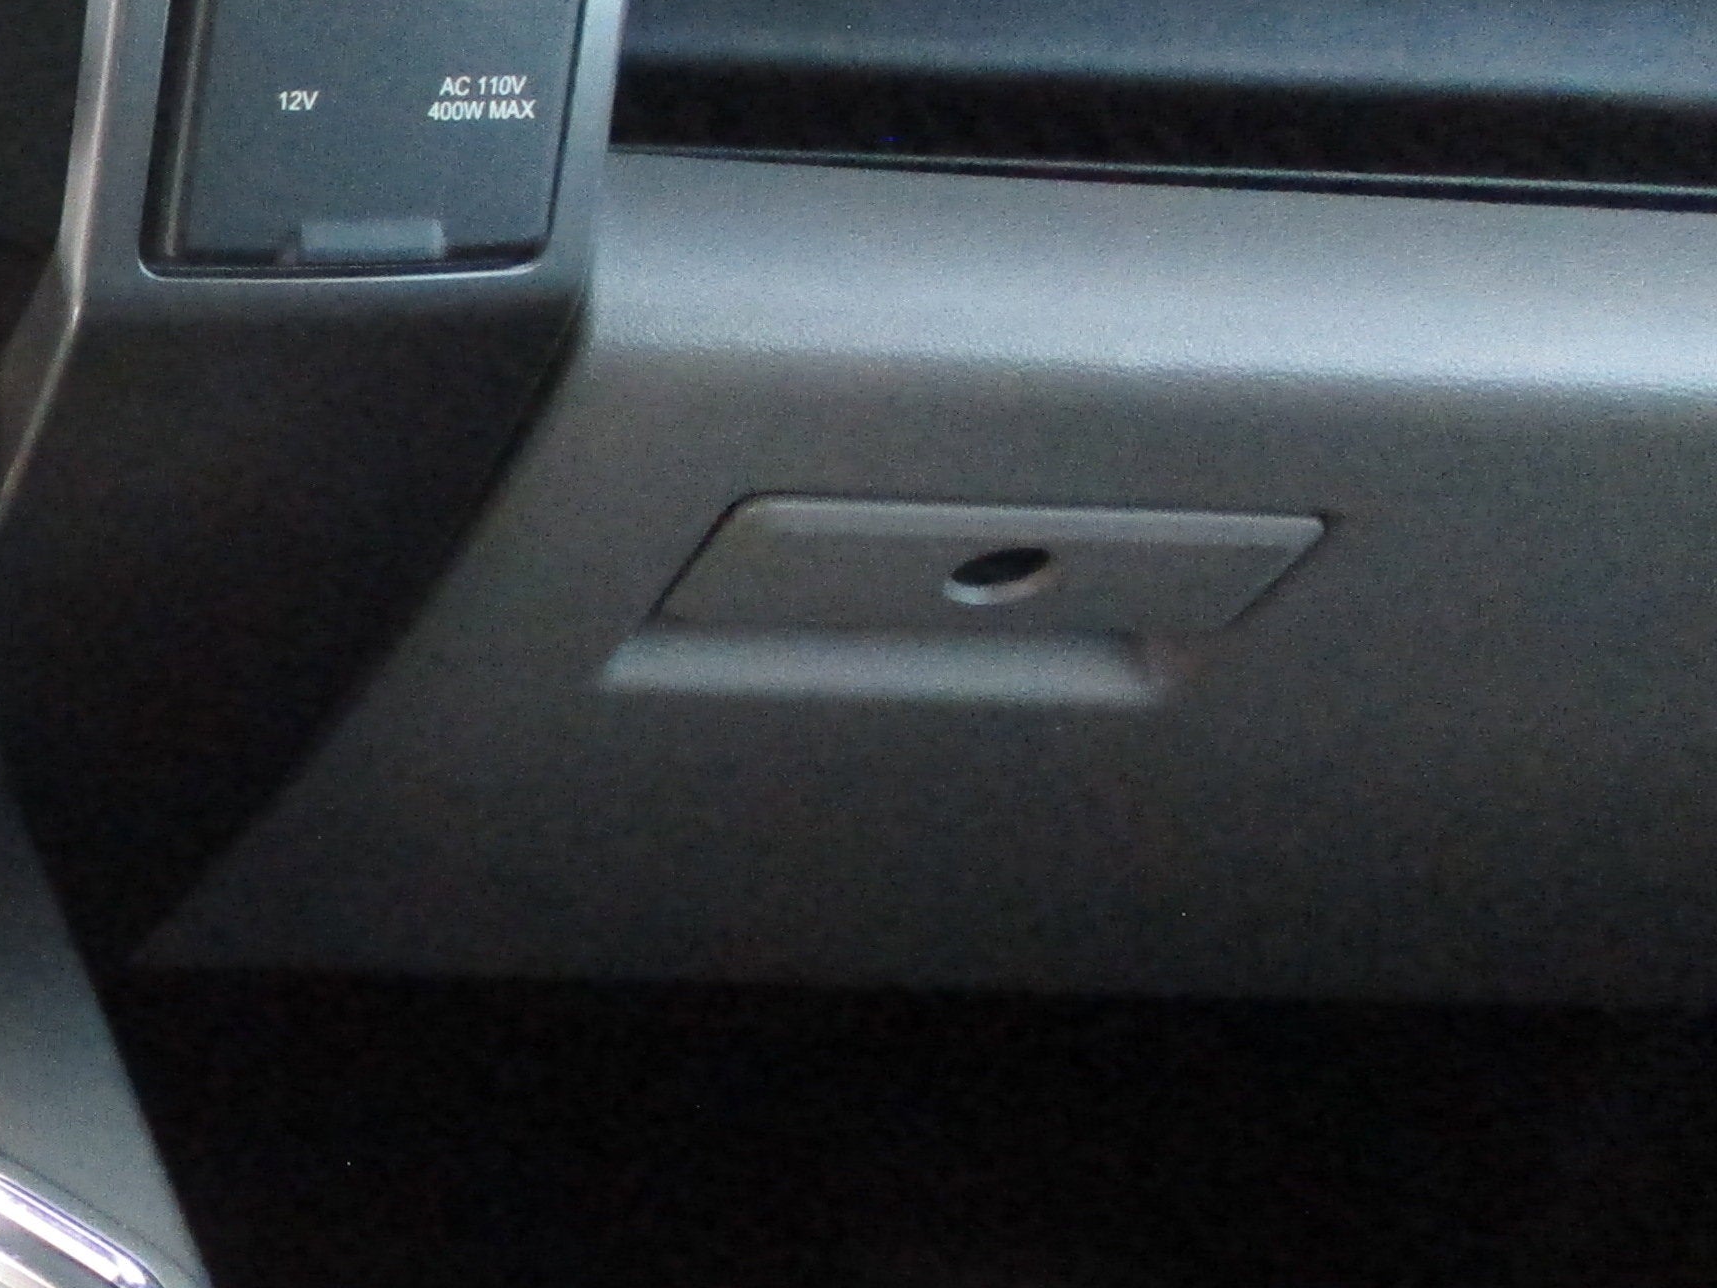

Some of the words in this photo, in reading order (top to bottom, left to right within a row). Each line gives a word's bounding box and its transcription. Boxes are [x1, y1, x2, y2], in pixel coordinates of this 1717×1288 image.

[439, 75, 471, 97] AC
[478, 75, 527, 96] 110V
[279, 90, 319, 111] 12V
[428, 100, 485, 121] 400W
[488, 99, 535, 120] MAX
